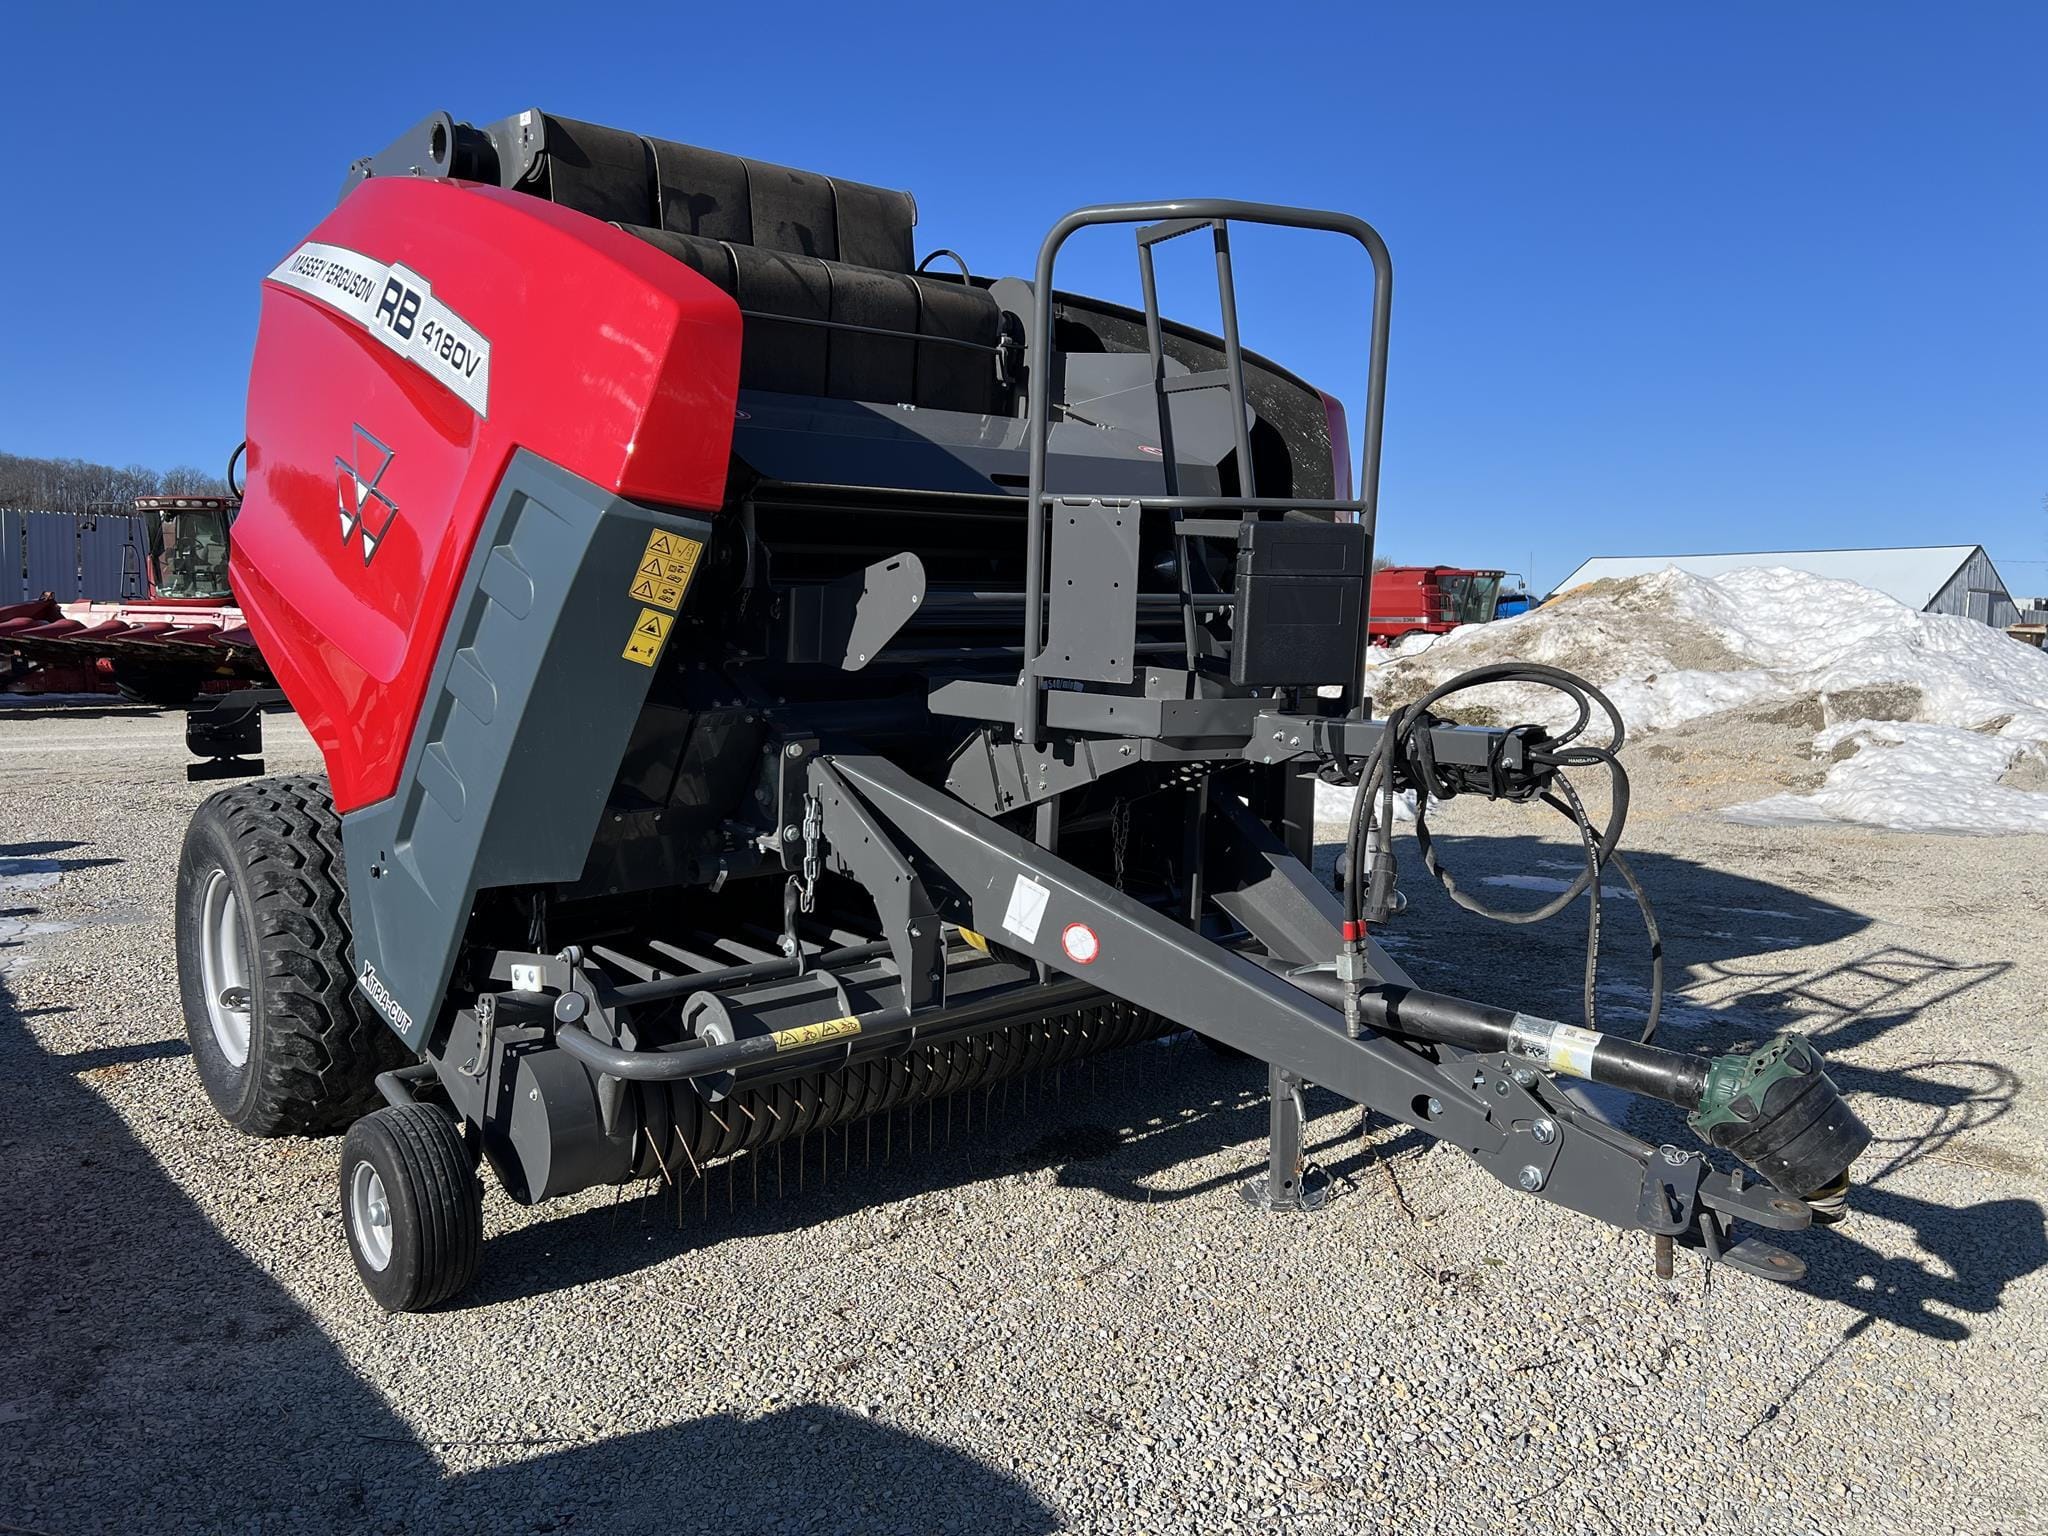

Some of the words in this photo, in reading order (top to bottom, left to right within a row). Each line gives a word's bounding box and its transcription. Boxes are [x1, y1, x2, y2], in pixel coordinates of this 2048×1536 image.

[291, 255, 327, 278] MASSEY
[325, 262, 376, 303] FERGUSON
[375, 276, 421, 341] RB
[422, 321, 481, 378] 4180V
[359, 960, 412, 1034] XTRA-CUT
